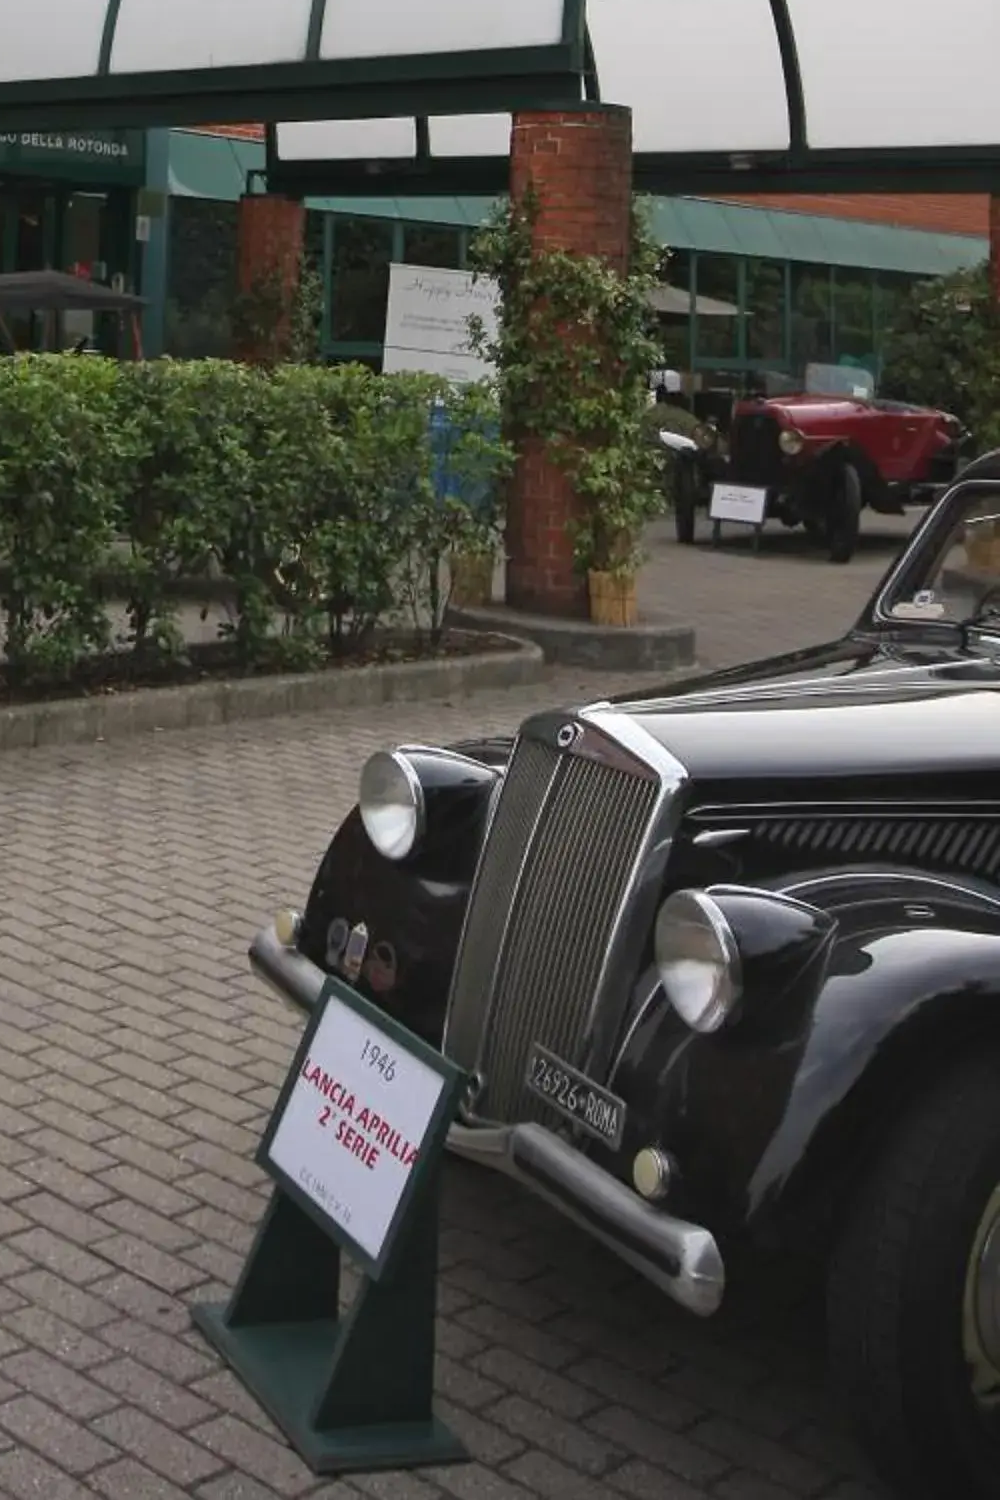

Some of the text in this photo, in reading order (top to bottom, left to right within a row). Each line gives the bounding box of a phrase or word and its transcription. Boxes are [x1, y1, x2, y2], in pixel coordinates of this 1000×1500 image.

[21, 132, 63, 149] DELLA
[68, 136, 128, 156] ROTONDA
[360, 1038, 396, 1082] 1946
[301, 1058, 420, 1169] LANCIA APRILIA
[335, 1120, 381, 1170] SERIE
